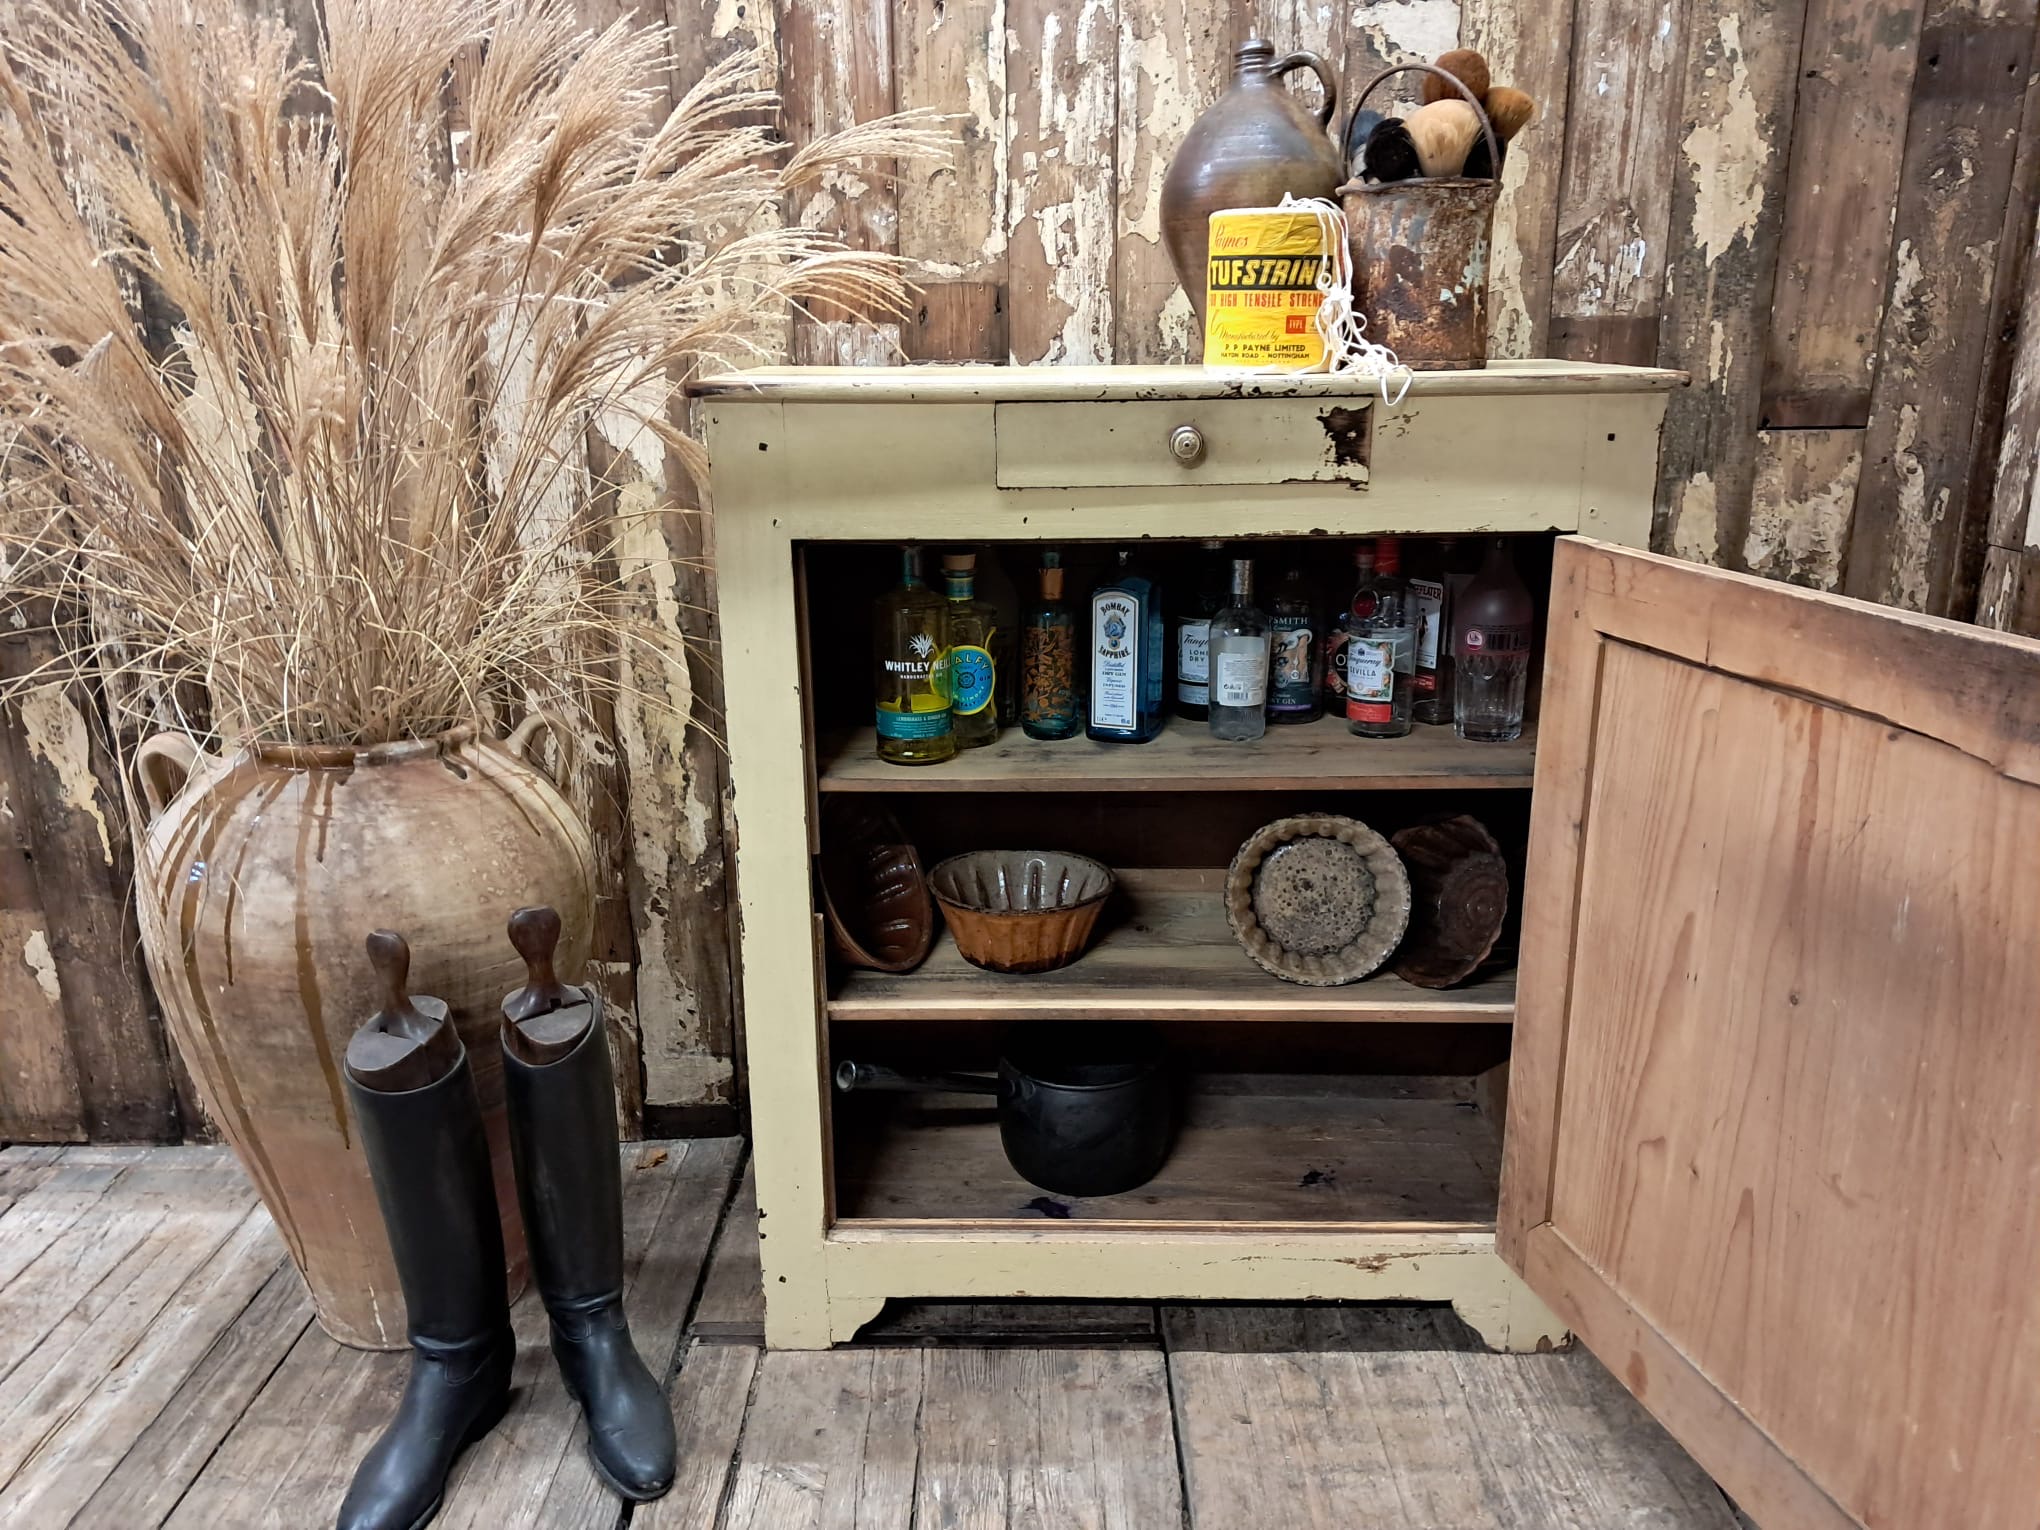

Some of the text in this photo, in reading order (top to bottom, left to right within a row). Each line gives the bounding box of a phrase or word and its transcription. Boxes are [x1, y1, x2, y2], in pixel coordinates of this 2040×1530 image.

[1245, 293, 1282, 308] TENSILE
[1289, 293, 1325, 308] STRENG
[1271, 327, 1280, 344] by
[1243, 343, 1271, 352] PAYNE
[1274, 344, 1306, 352] LIMITED
[1241, 352, 1259, 360] ROAD
[1100, 602, 1130, 616] BOMBAY
[1098, 644, 1132, 659] SAPPHIRE
[884, 659, 930, 673] WHITLEY
[954, 653, 989, 670] ALFY
[1350, 666, 1376, 677] SEVILLA
[1282, 697, 1297, 705] GIN
